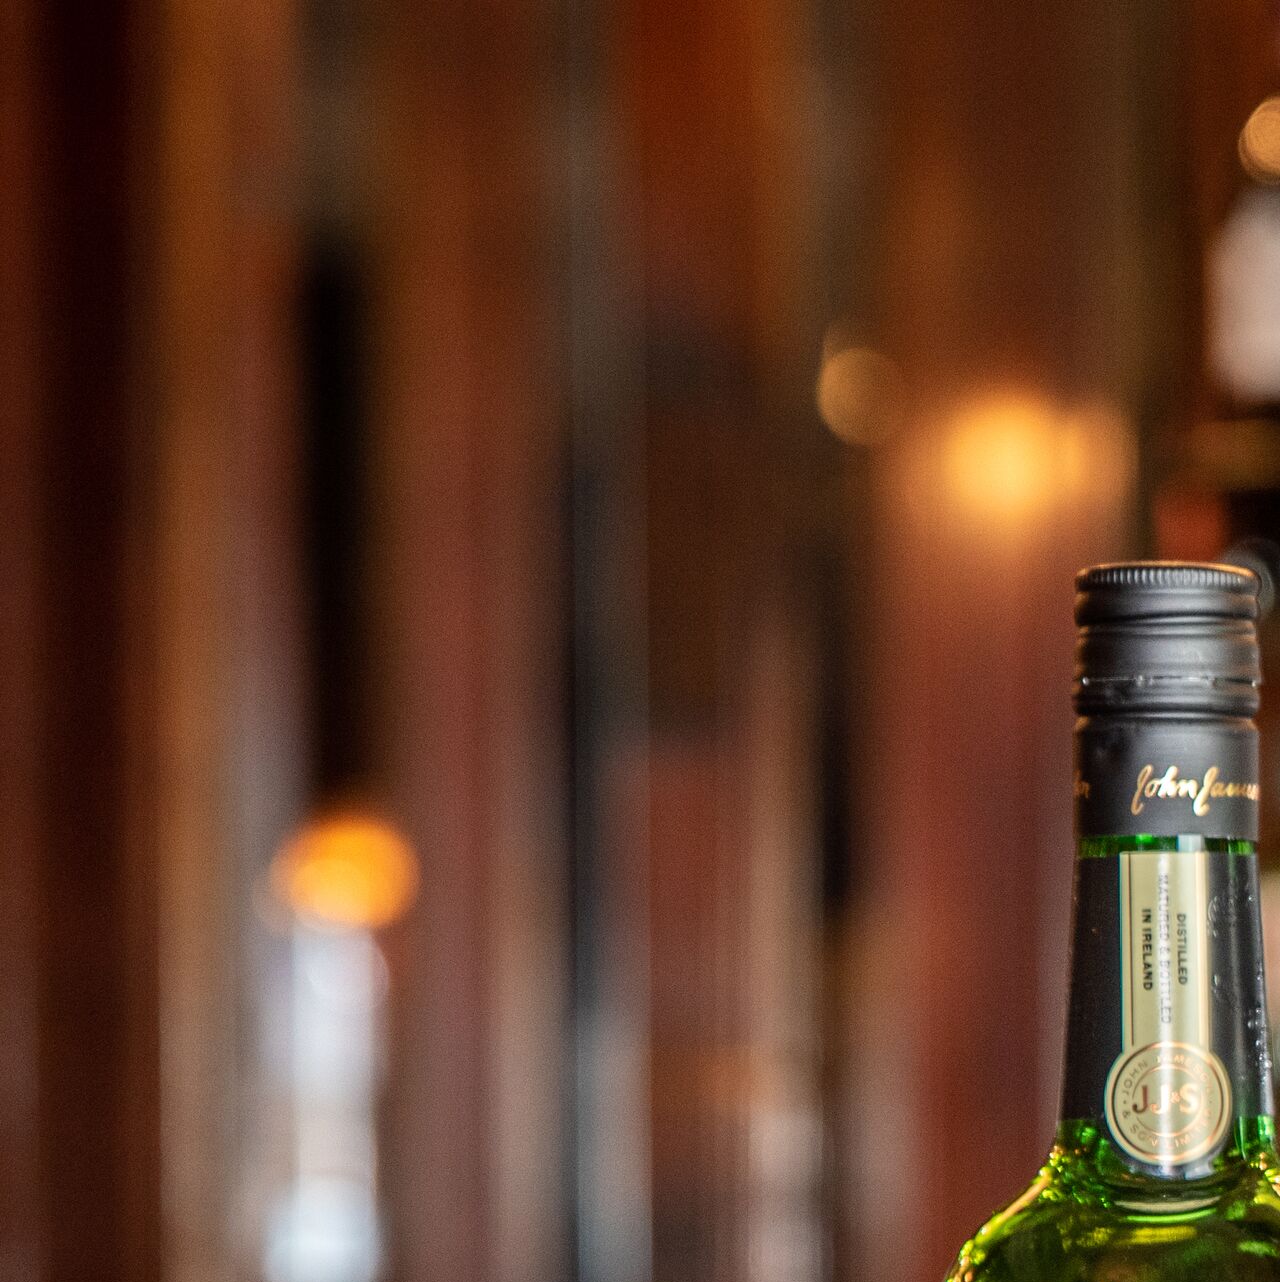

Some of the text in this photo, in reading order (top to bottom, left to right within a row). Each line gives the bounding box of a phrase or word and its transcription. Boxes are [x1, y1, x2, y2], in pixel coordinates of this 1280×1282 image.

[1131, 764, 1198, 816] John
[1142, 908, 1153, 991] IN IRELAND
[1176, 913, 1188, 985] DISTILLED
